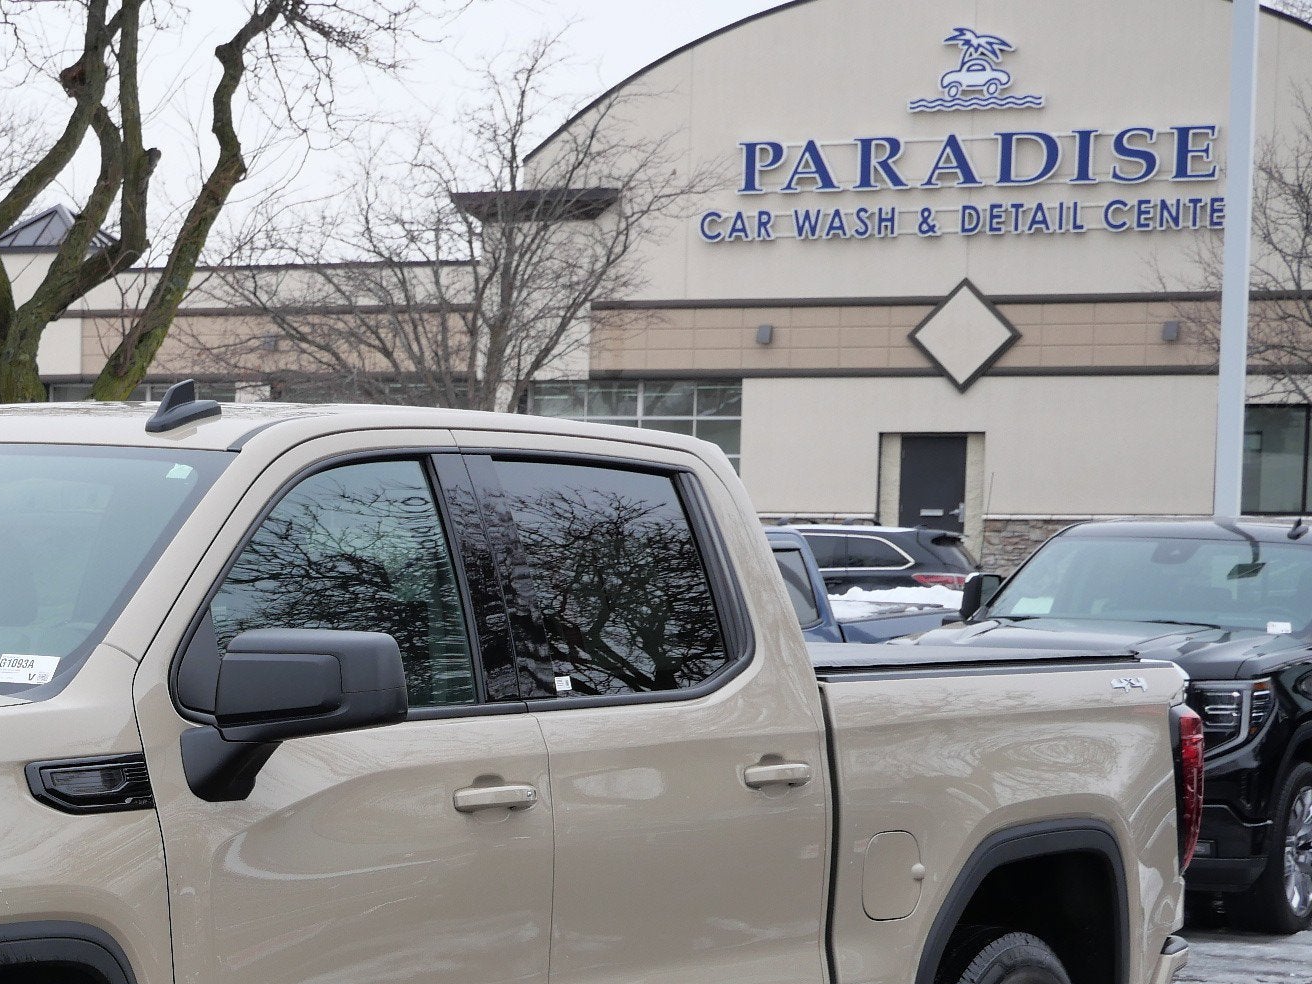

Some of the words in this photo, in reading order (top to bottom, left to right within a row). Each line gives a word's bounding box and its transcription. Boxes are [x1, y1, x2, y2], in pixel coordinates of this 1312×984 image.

[737, 124, 1218, 194] PARADISE
[700, 209, 772, 241] CAR
[794, 206, 897, 238] WASH
[918, 206, 938, 235] &
[960, 202, 1084, 233] DETAIL
[1104, 197, 1225, 230] CENTE
